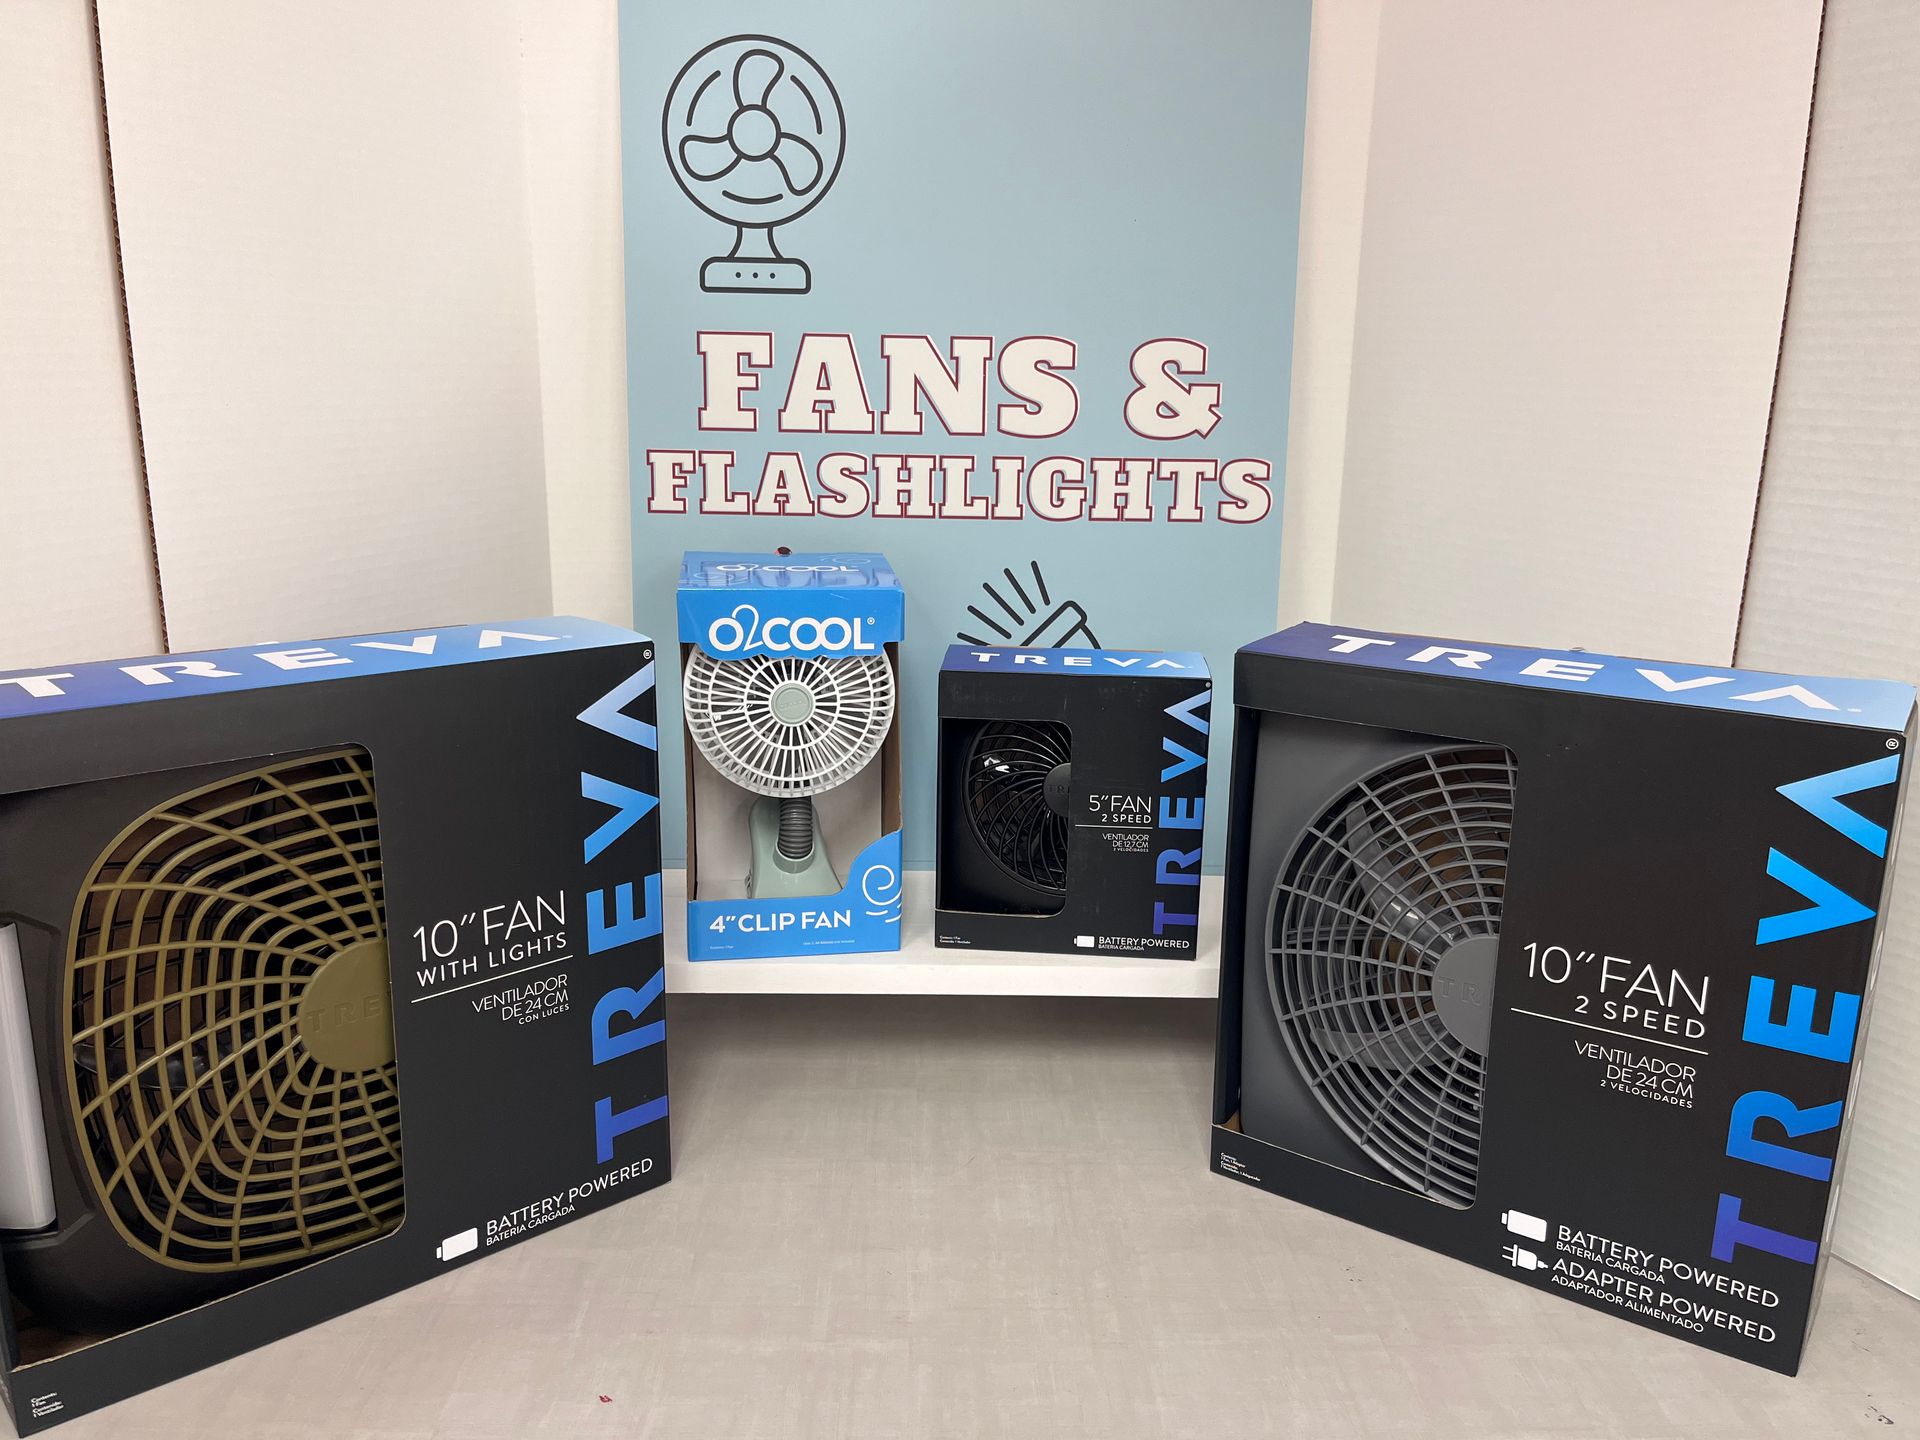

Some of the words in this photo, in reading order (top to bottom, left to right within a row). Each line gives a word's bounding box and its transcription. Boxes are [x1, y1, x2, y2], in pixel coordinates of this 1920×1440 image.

[697, 331, 1079, 439] FANS
[1123, 337, 1222, 440] &
[647, 450, 1271, 524] FLASHLIGHTS
[0, 628, 560, 699] TREVA
[970, 652, 1186, 669] TREVA
[1328, 634, 1841, 712] TREVA
[1101, 813, 1108, 823] 2
[1112, 814, 1152, 824] SPEED
[1153, 689, 1212, 935] TREVA
[1102, 833, 1149, 841] VENTILADOR
[577, 659, 670, 1165] TREVA
[801, 909, 851, 930] FAN
[416, 955, 478, 988] WITH
[489, 931, 567, 969] LIGHTS
[1098, 936, 1139, 946] BATTERY
[1141, 938, 1190, 949] POWERED
[472, 973, 568, 1013] VENTILADOR
[502, 1003, 522, 1022] DE
[525, 996, 542, 1014] 24
[544, 989, 569, 1008] CM
[518, 1012, 539, 1025] CON
[542, 1003, 570, 1018] LUCES
[1574, 995, 1589, 1014] 2
[1603, 1001, 1705, 1039] SPEED
[1574, 1039, 1697, 1083] VENTILADOR
[1606, 1064, 1633, 1084] DE
[1636, 1072, 1658, 1090] 24
[1661, 1078, 1694, 1099] CM
[1600, 1079, 1606, 1088] 2
[1610, 1081, 1693, 1109] VELOCIDADES
[486, 1192, 565, 1236] BATTERY
[569, 1157, 654, 1204] POWERED
[486, 1223, 527, 1247] BATERIA
[528, 1204, 576, 1229] CARGADA
[1556, 1239, 1603, 1264] BATERIA
[1605, 1256, 1665, 1285] CARGADA
[1558, 1224, 1654, 1268] BATTERY
[1659, 1257, 1779, 1309] POWERED
[1551, 1275, 1624, 1306] ADAPTADOR
[1624, 1300, 1705, 1333] ALIMENTADO
[1552, 1257, 1653, 1304] ADAPTER
[1659, 1291, 1777, 1343] POWERED
